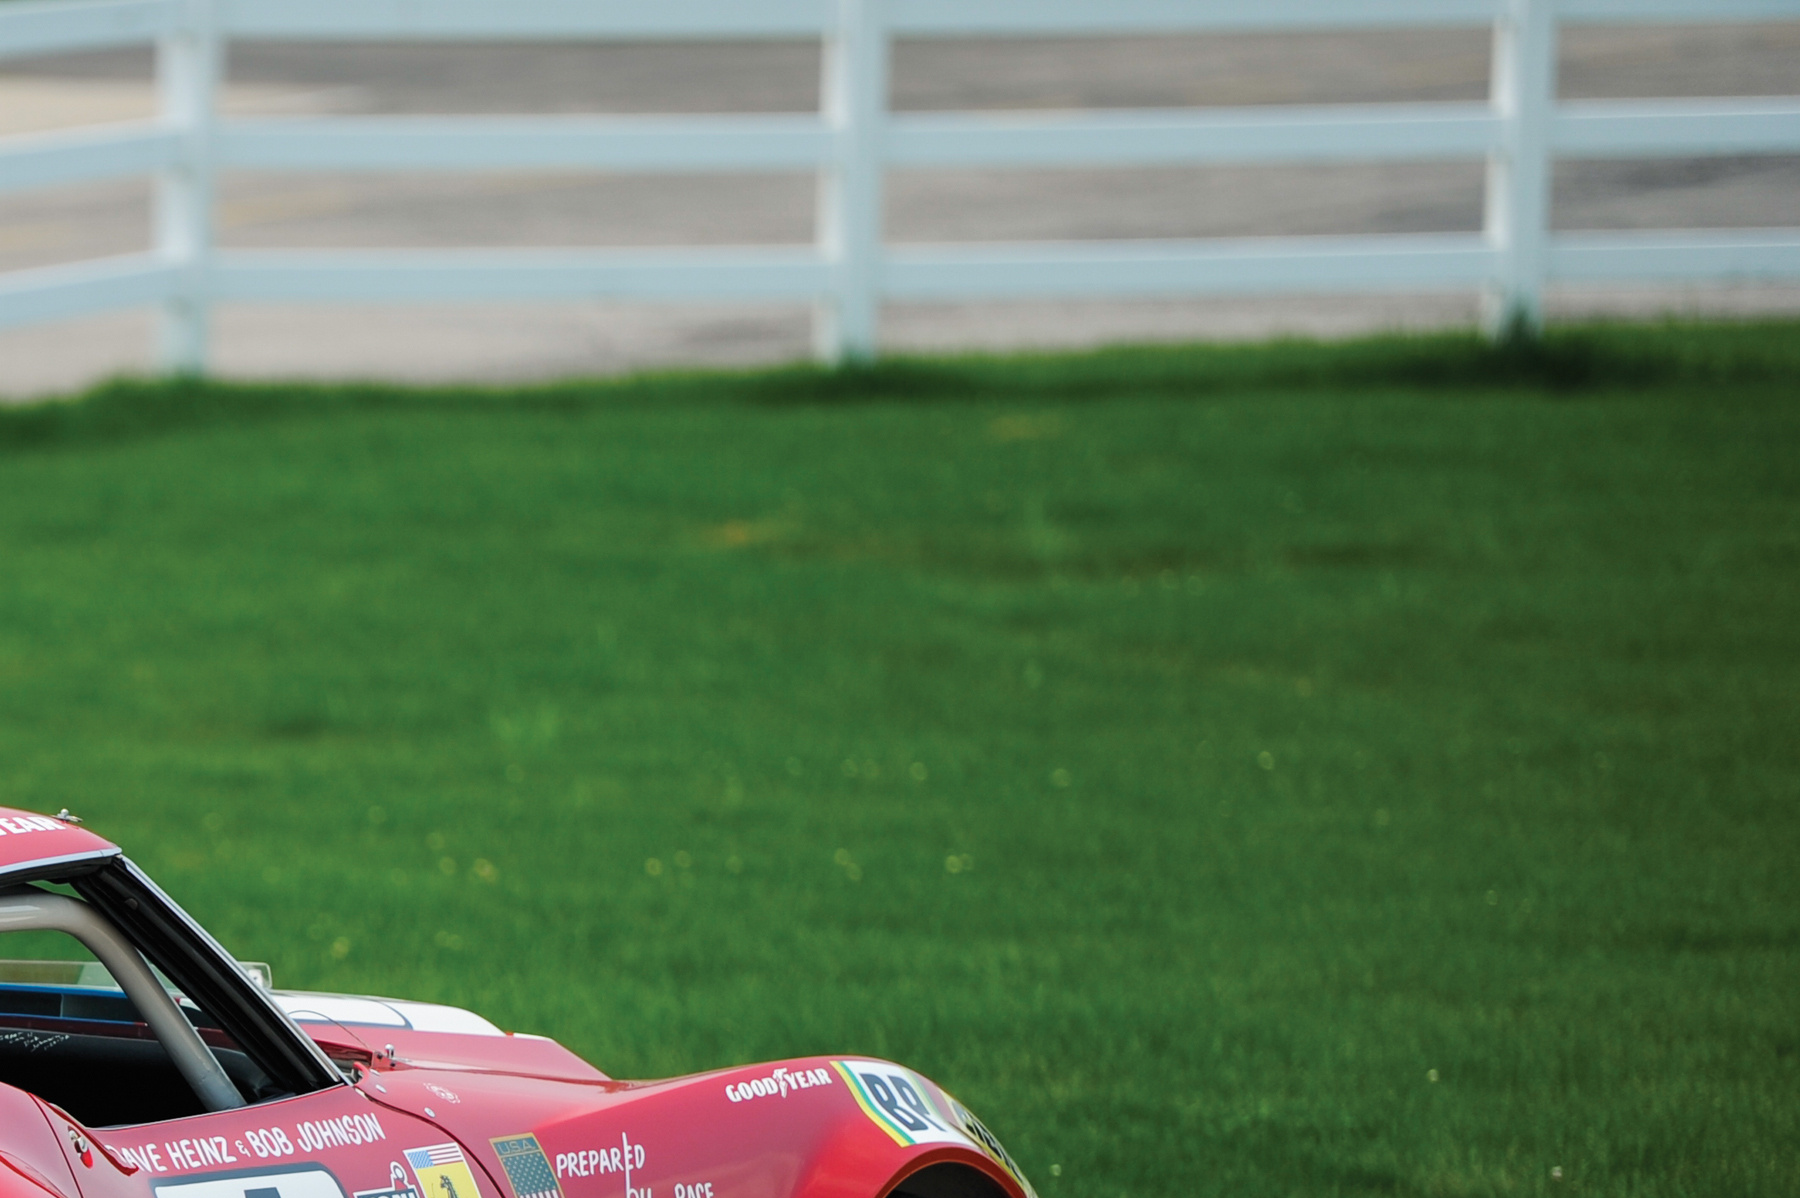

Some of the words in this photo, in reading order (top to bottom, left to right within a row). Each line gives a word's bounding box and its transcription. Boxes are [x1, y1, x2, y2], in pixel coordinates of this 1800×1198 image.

[165, 1136, 237, 1171] HEINZ
[235, 1140, 251, 1157] &
[244, 1127, 294, 1158] BOB
[296, 1112, 386, 1153] JOHNSON
[556, 1142, 646, 1179] PREPARED
